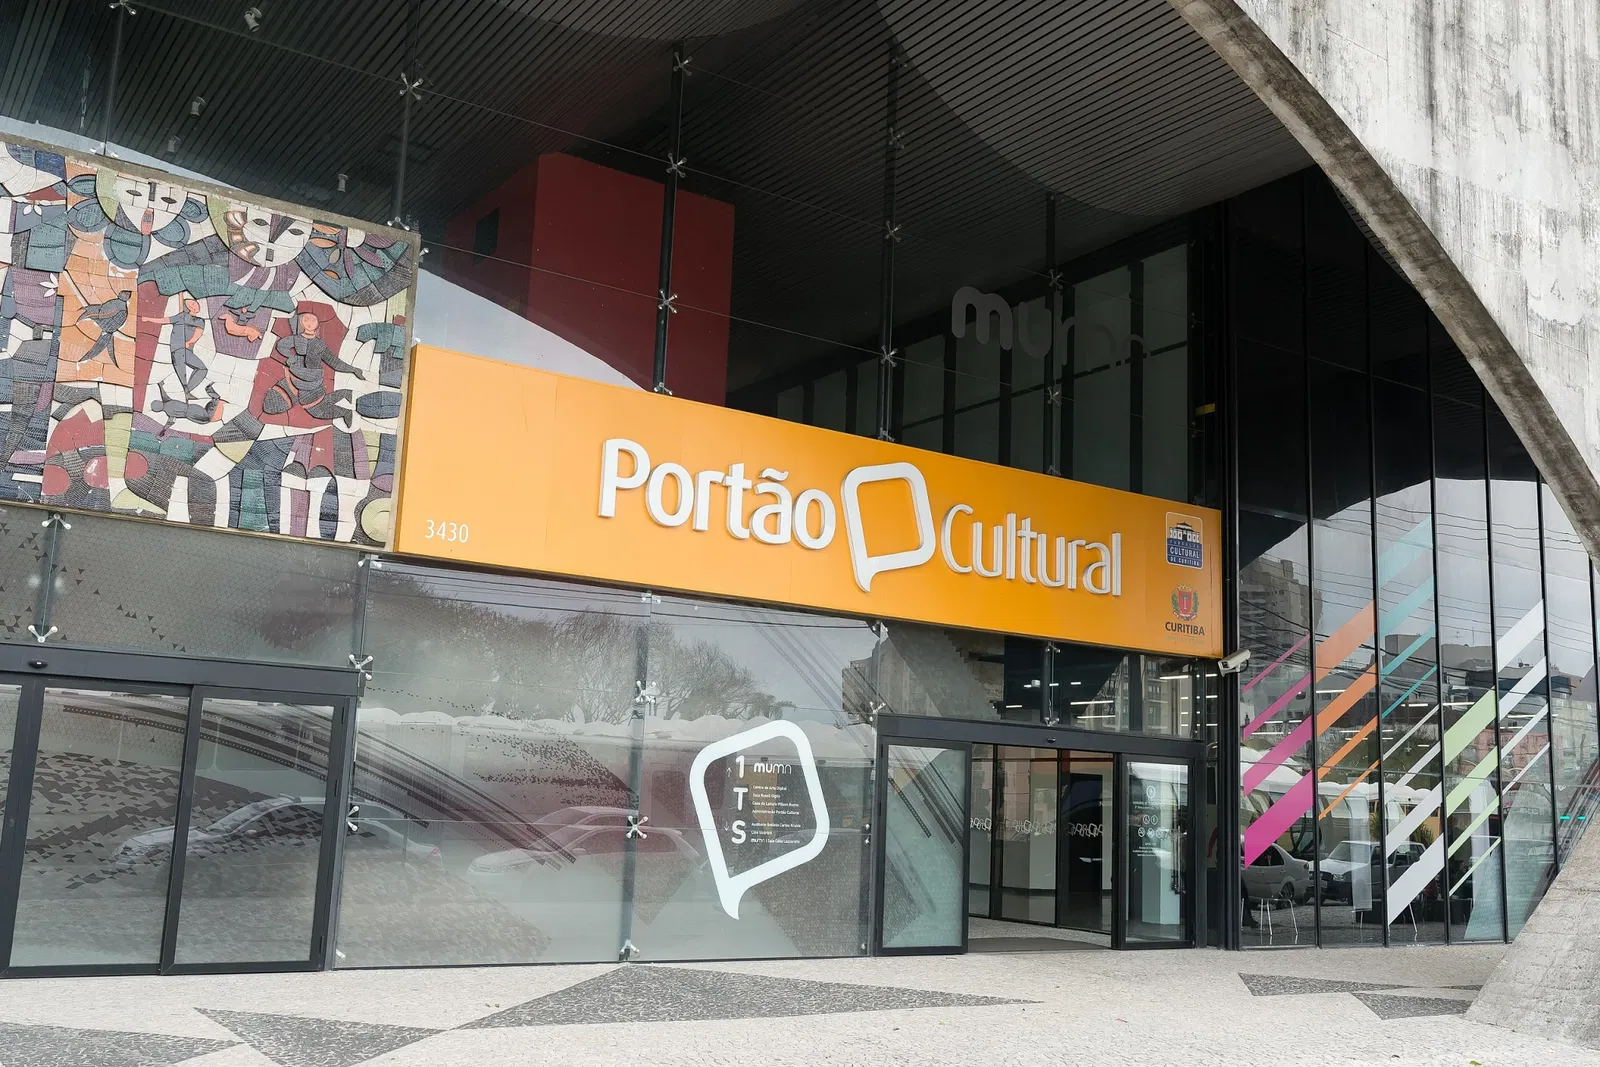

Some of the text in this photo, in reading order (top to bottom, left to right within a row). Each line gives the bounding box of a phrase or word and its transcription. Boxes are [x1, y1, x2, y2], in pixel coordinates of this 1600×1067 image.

[598, 438, 1121, 597] Portão Cultural
[424, 519, 469, 543] 3430
[1169, 546, 1200, 559] CULTURAL
[1178, 557, 1200, 567] CURITIBA
[1165, 621, 1205, 636] CURITIBA
[736, 755, 744, 778] 1
[733, 787, 748, 810] T
[731, 820, 747, 844] S
